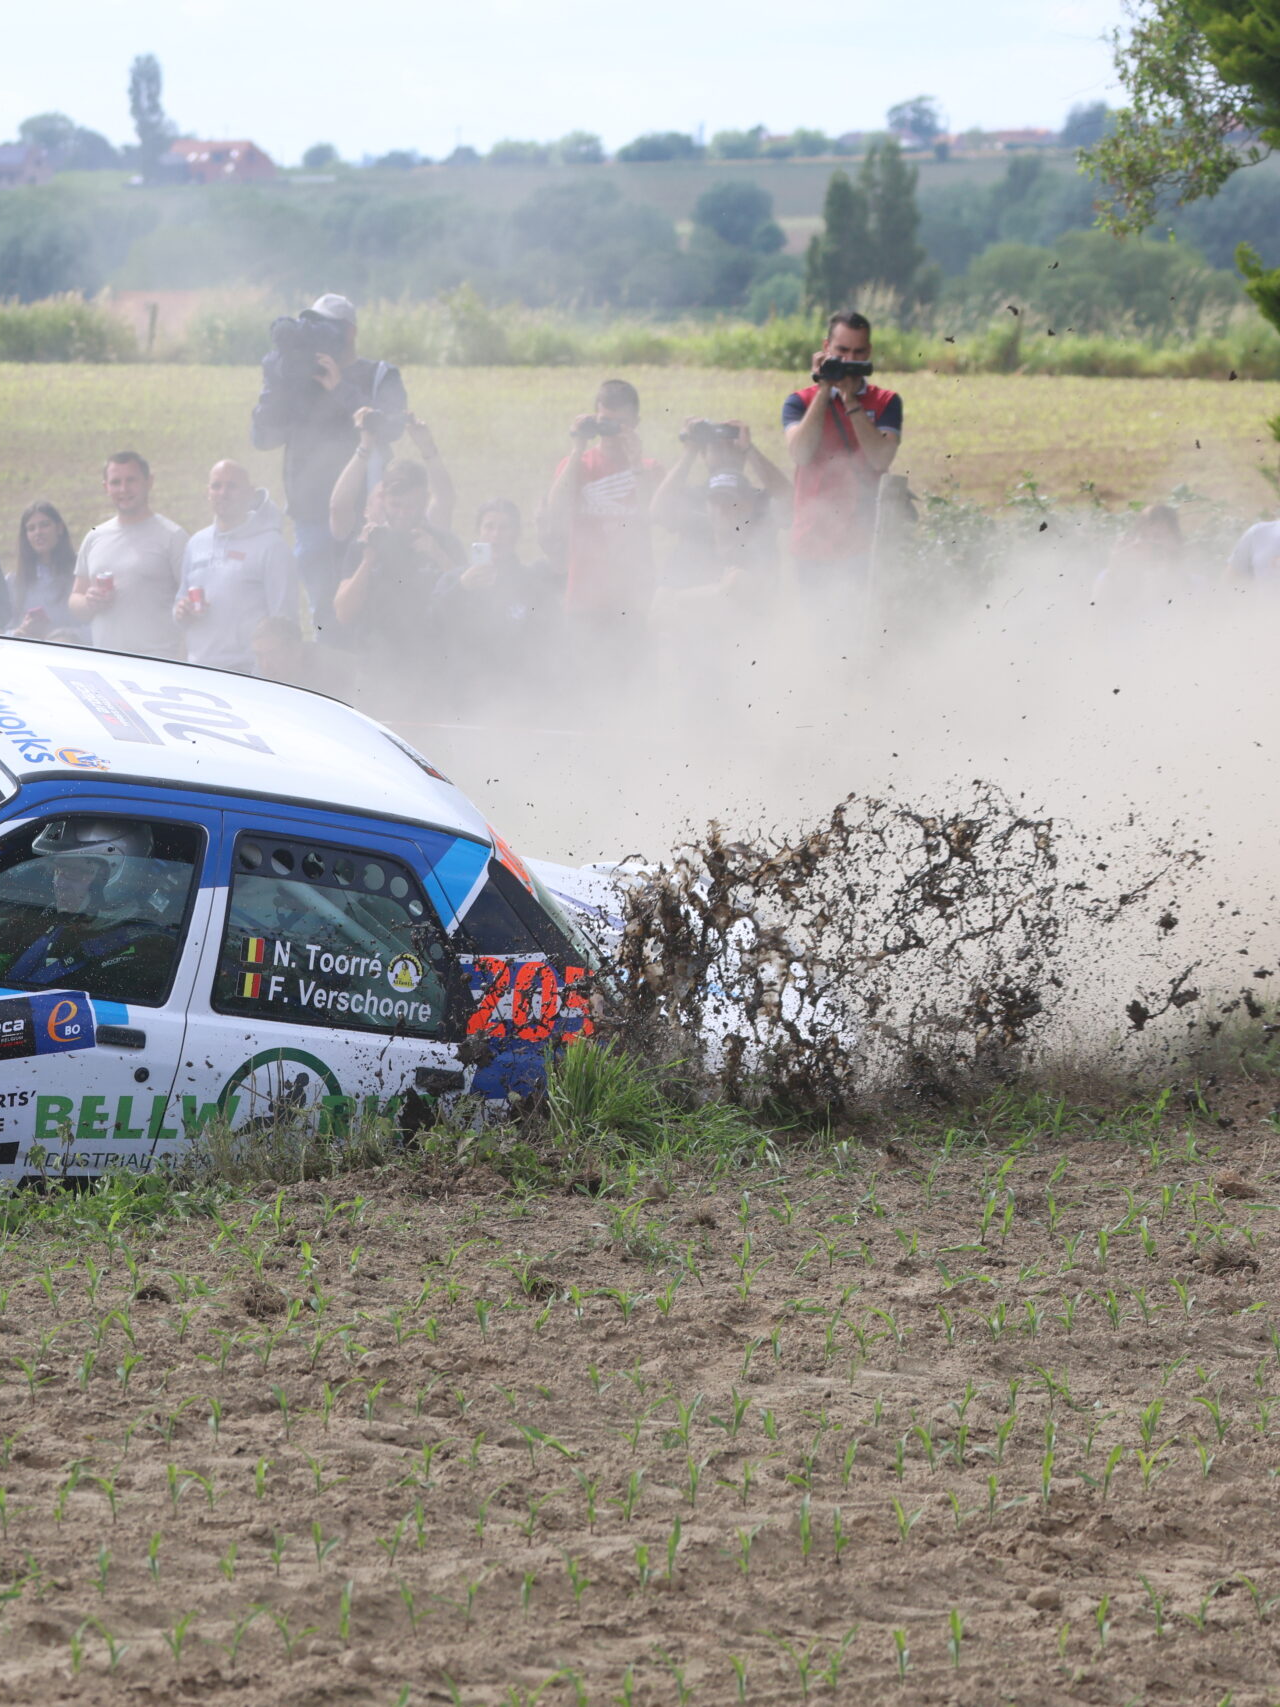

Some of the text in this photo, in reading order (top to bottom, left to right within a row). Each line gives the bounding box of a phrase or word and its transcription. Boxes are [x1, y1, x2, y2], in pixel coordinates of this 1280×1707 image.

[273, 940, 382, 979] N. Toorré
[268, 975, 432, 1023] F. Verschoore
[64, 1025, 81, 1036] BO
